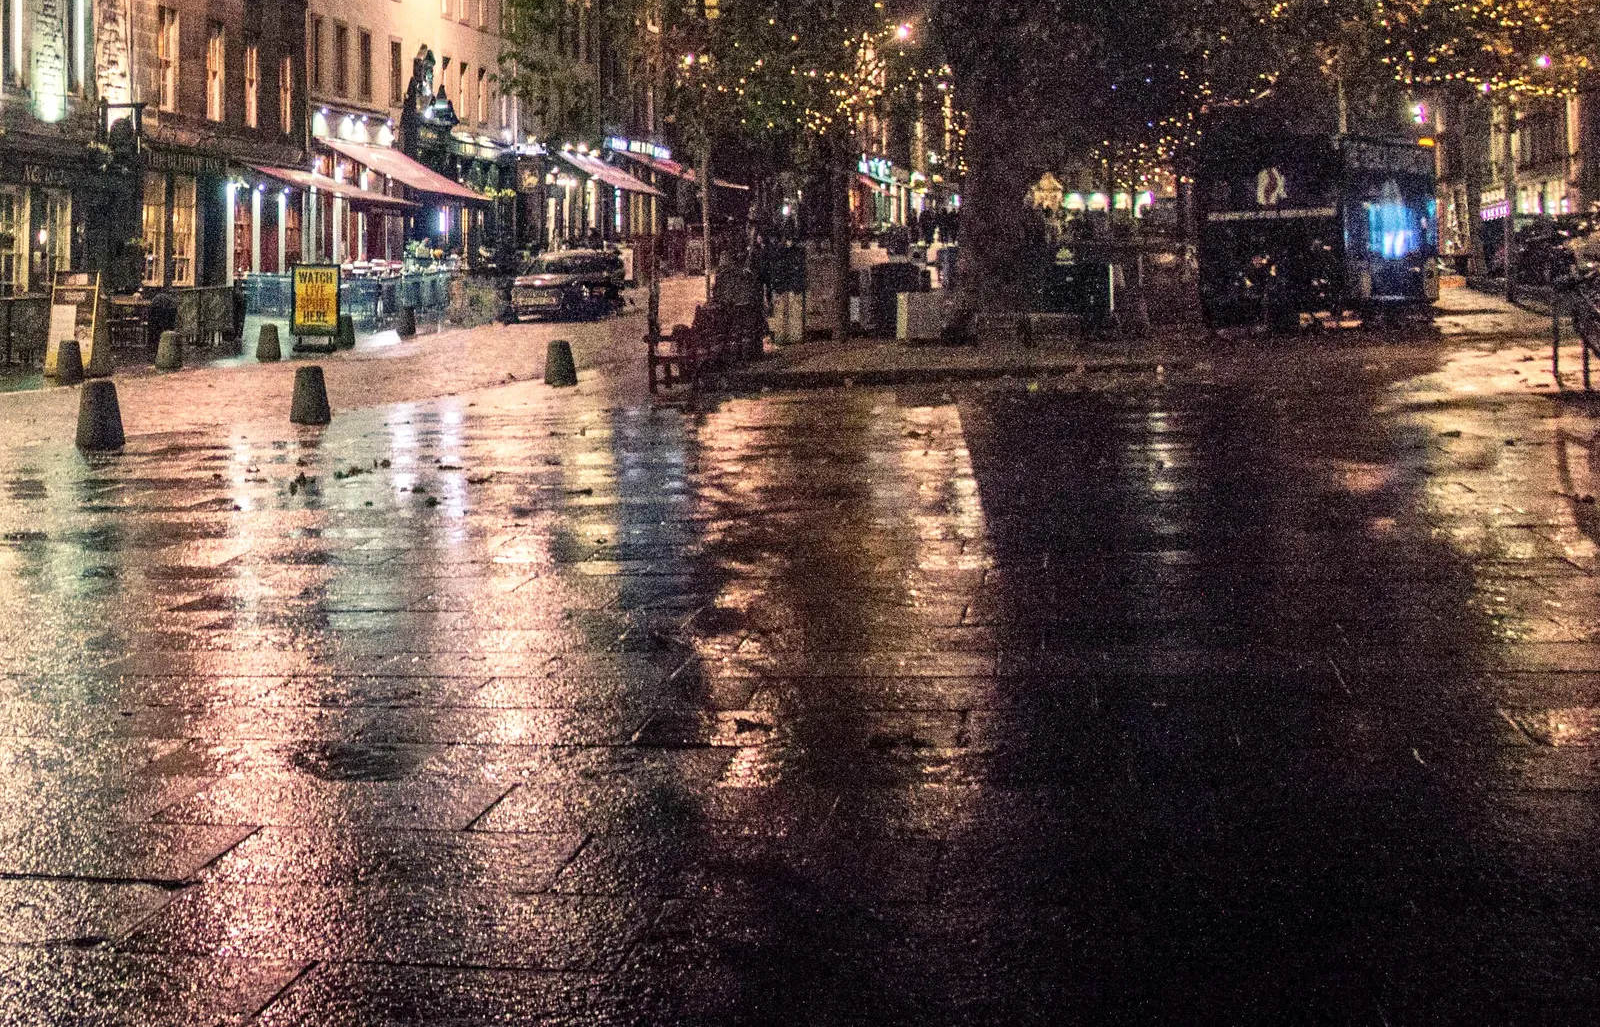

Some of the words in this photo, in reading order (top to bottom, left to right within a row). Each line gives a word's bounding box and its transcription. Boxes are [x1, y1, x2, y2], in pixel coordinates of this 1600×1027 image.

[298, 271, 333, 284] WATCH
[304, 285, 326, 297] LIVE
[299, 297, 331, 311] SPORT
[303, 310, 329, 323] HERE
